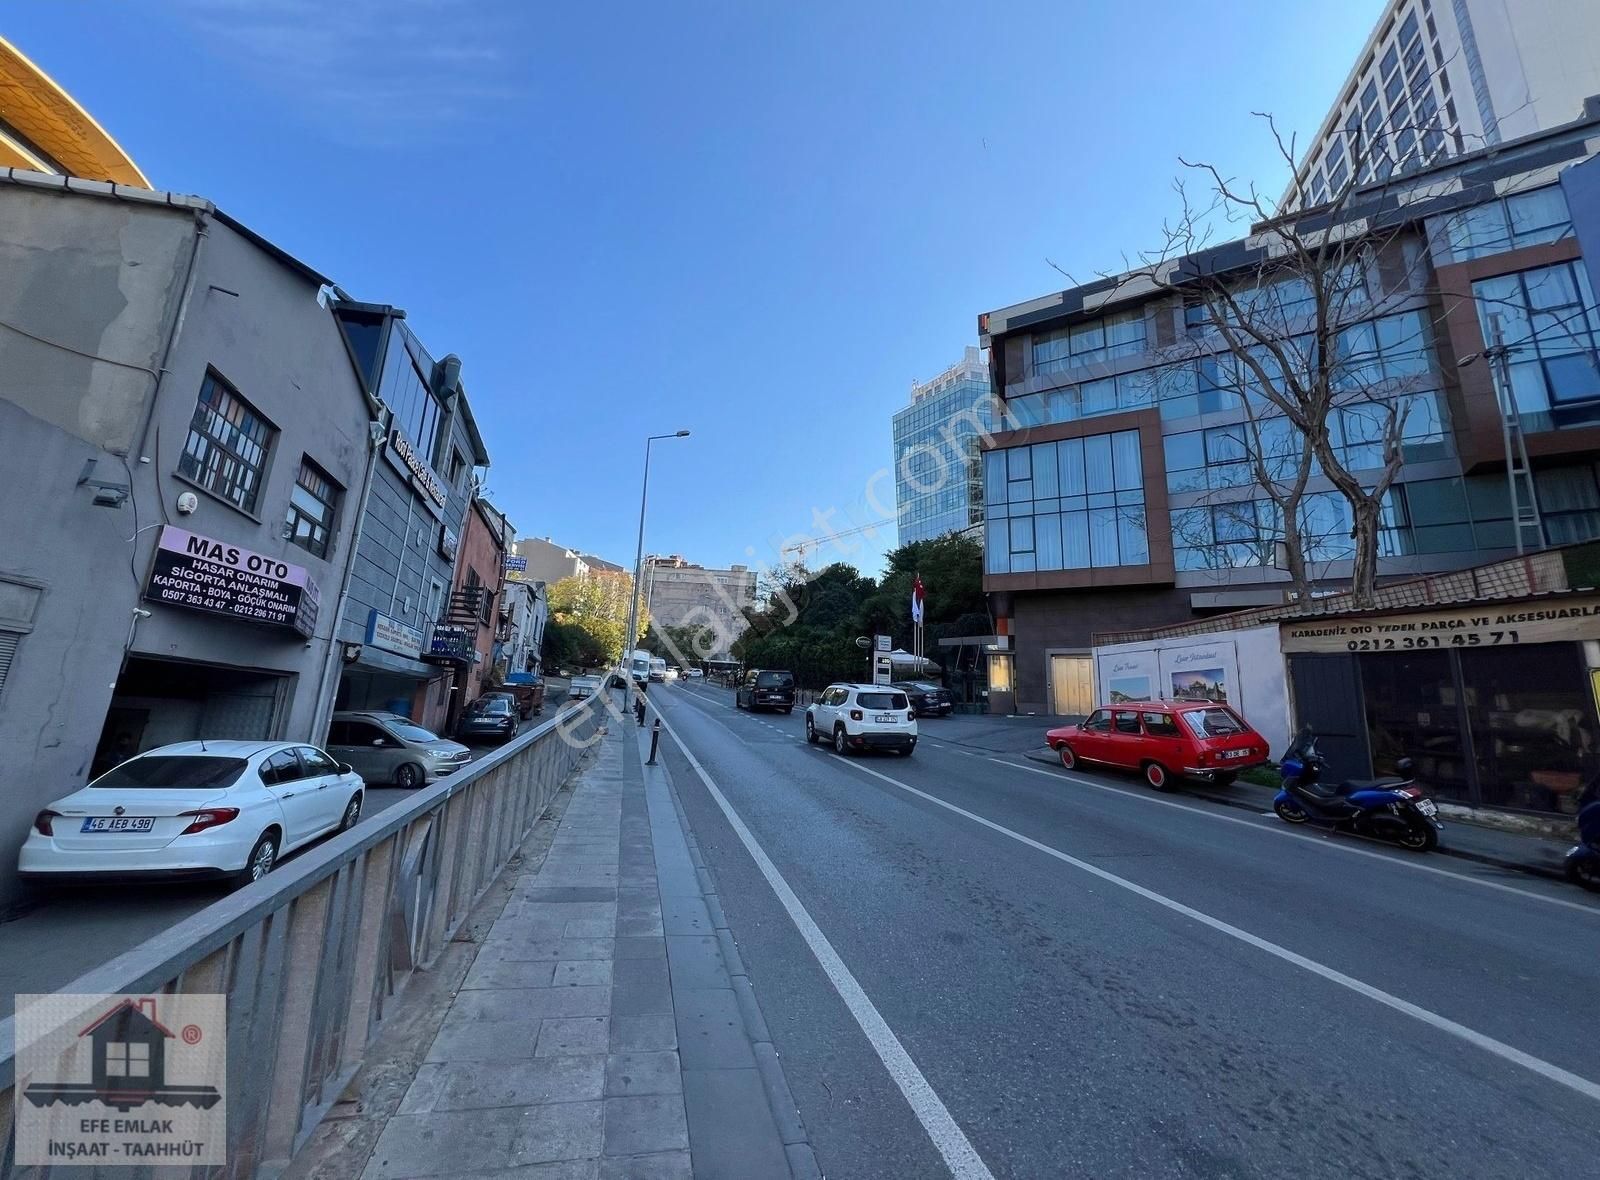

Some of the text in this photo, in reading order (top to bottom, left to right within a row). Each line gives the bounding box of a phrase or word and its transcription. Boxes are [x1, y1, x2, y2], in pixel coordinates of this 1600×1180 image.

[186, 536, 288, 578] MAS OTO
[171, 566, 226, 588] SİGORTA
[229, 581, 288, 602] ANLAŞMALI
[192, 560, 280, 590] HASAR ONARIM
[153, 574, 201, 593] KAPORTA
[208, 587, 230, 600] BOYA
[238, 592, 267, 608] GÖÇÜK
[268, 600, 296, 614] ONARIM
[162, 589, 185, 601] 0507
[204, 597, 215, 608] 43
[215, 600, 226, 610] 47
[234, 604, 253, 616] 0212
[267, 610, 276, 620] 71
[1291, 626, 1347, 638] KARADENİZ
[1350, 626, 1372, 634] OTO
[1378, 622, 1416, 632] YEDEK
[1420, 619, 1466, 630] PARÇA
[1470, 617, 1489, 627] VE
[1348, 630, 1519, 651] 0212 361 45 71
[91, 820, 150, 828] 46 AEB 498
